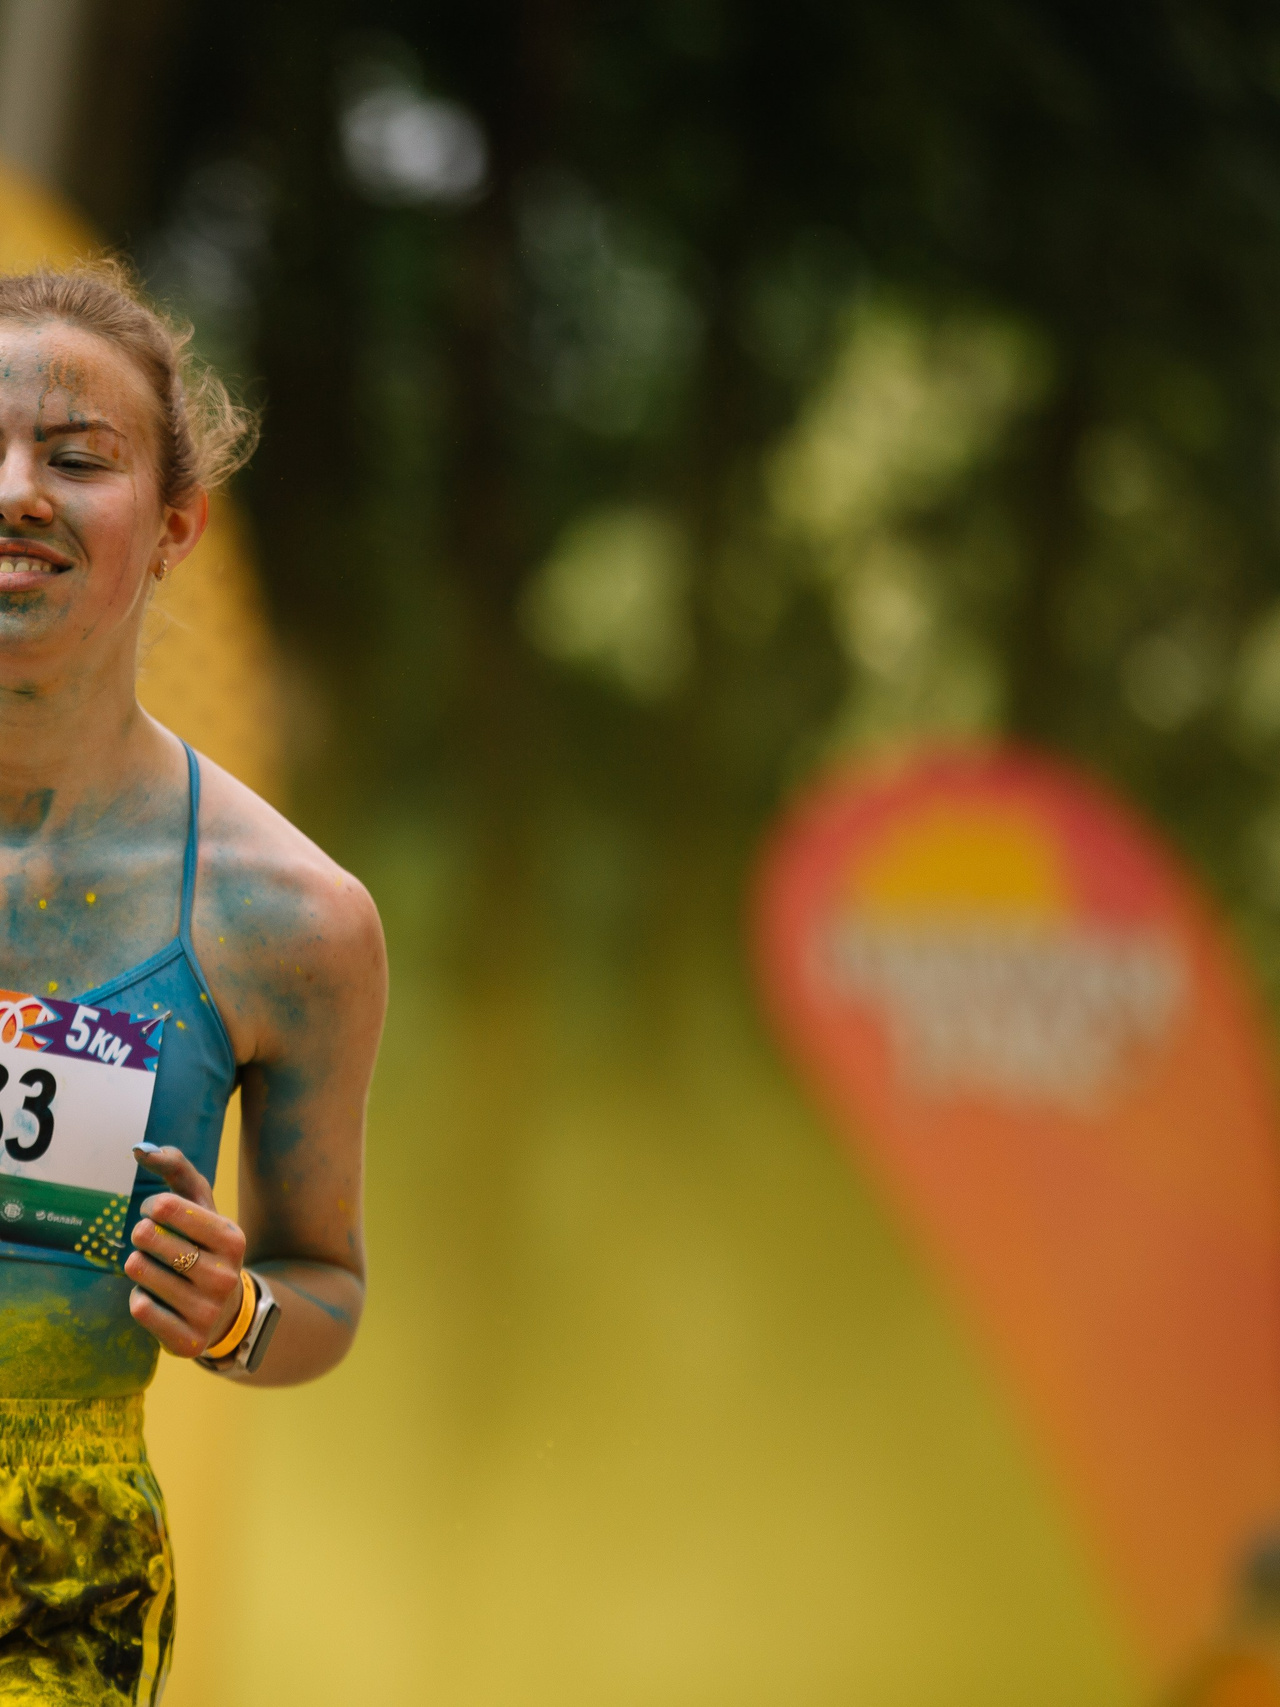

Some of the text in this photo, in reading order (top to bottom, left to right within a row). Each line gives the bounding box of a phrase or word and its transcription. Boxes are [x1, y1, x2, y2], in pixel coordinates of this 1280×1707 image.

[65, 1004, 133, 1068] 5 КМ
[46, 1211, 83, 1227] билайн
